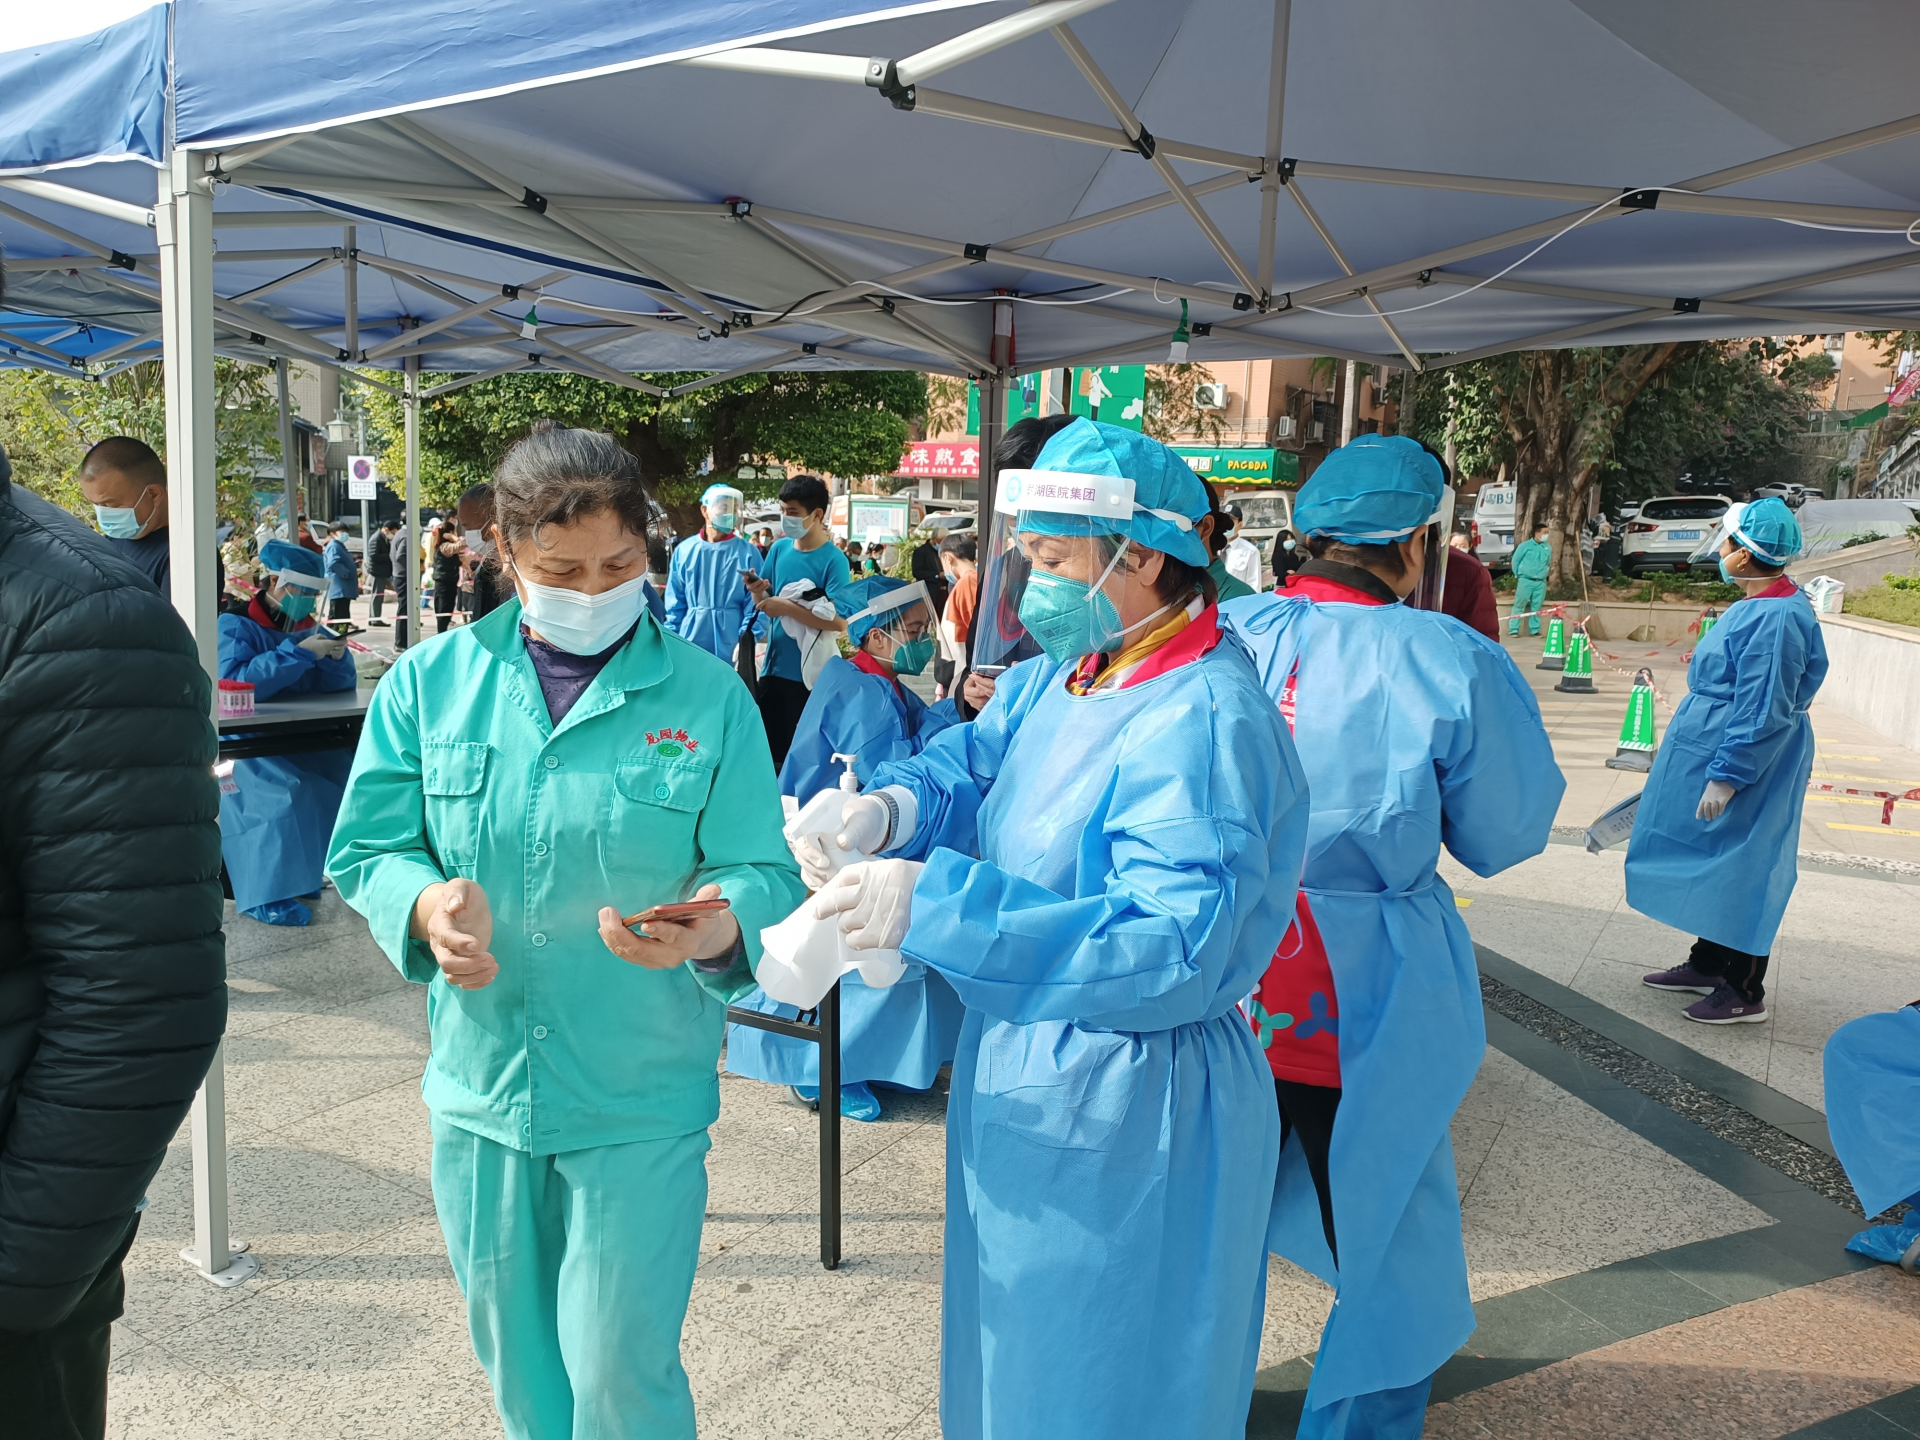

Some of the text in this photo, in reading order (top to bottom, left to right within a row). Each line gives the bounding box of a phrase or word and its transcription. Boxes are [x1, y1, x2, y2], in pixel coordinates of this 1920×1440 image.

[899, 447, 979, 467] 味熟食
[1227, 460, 1268, 471] PAGODA
